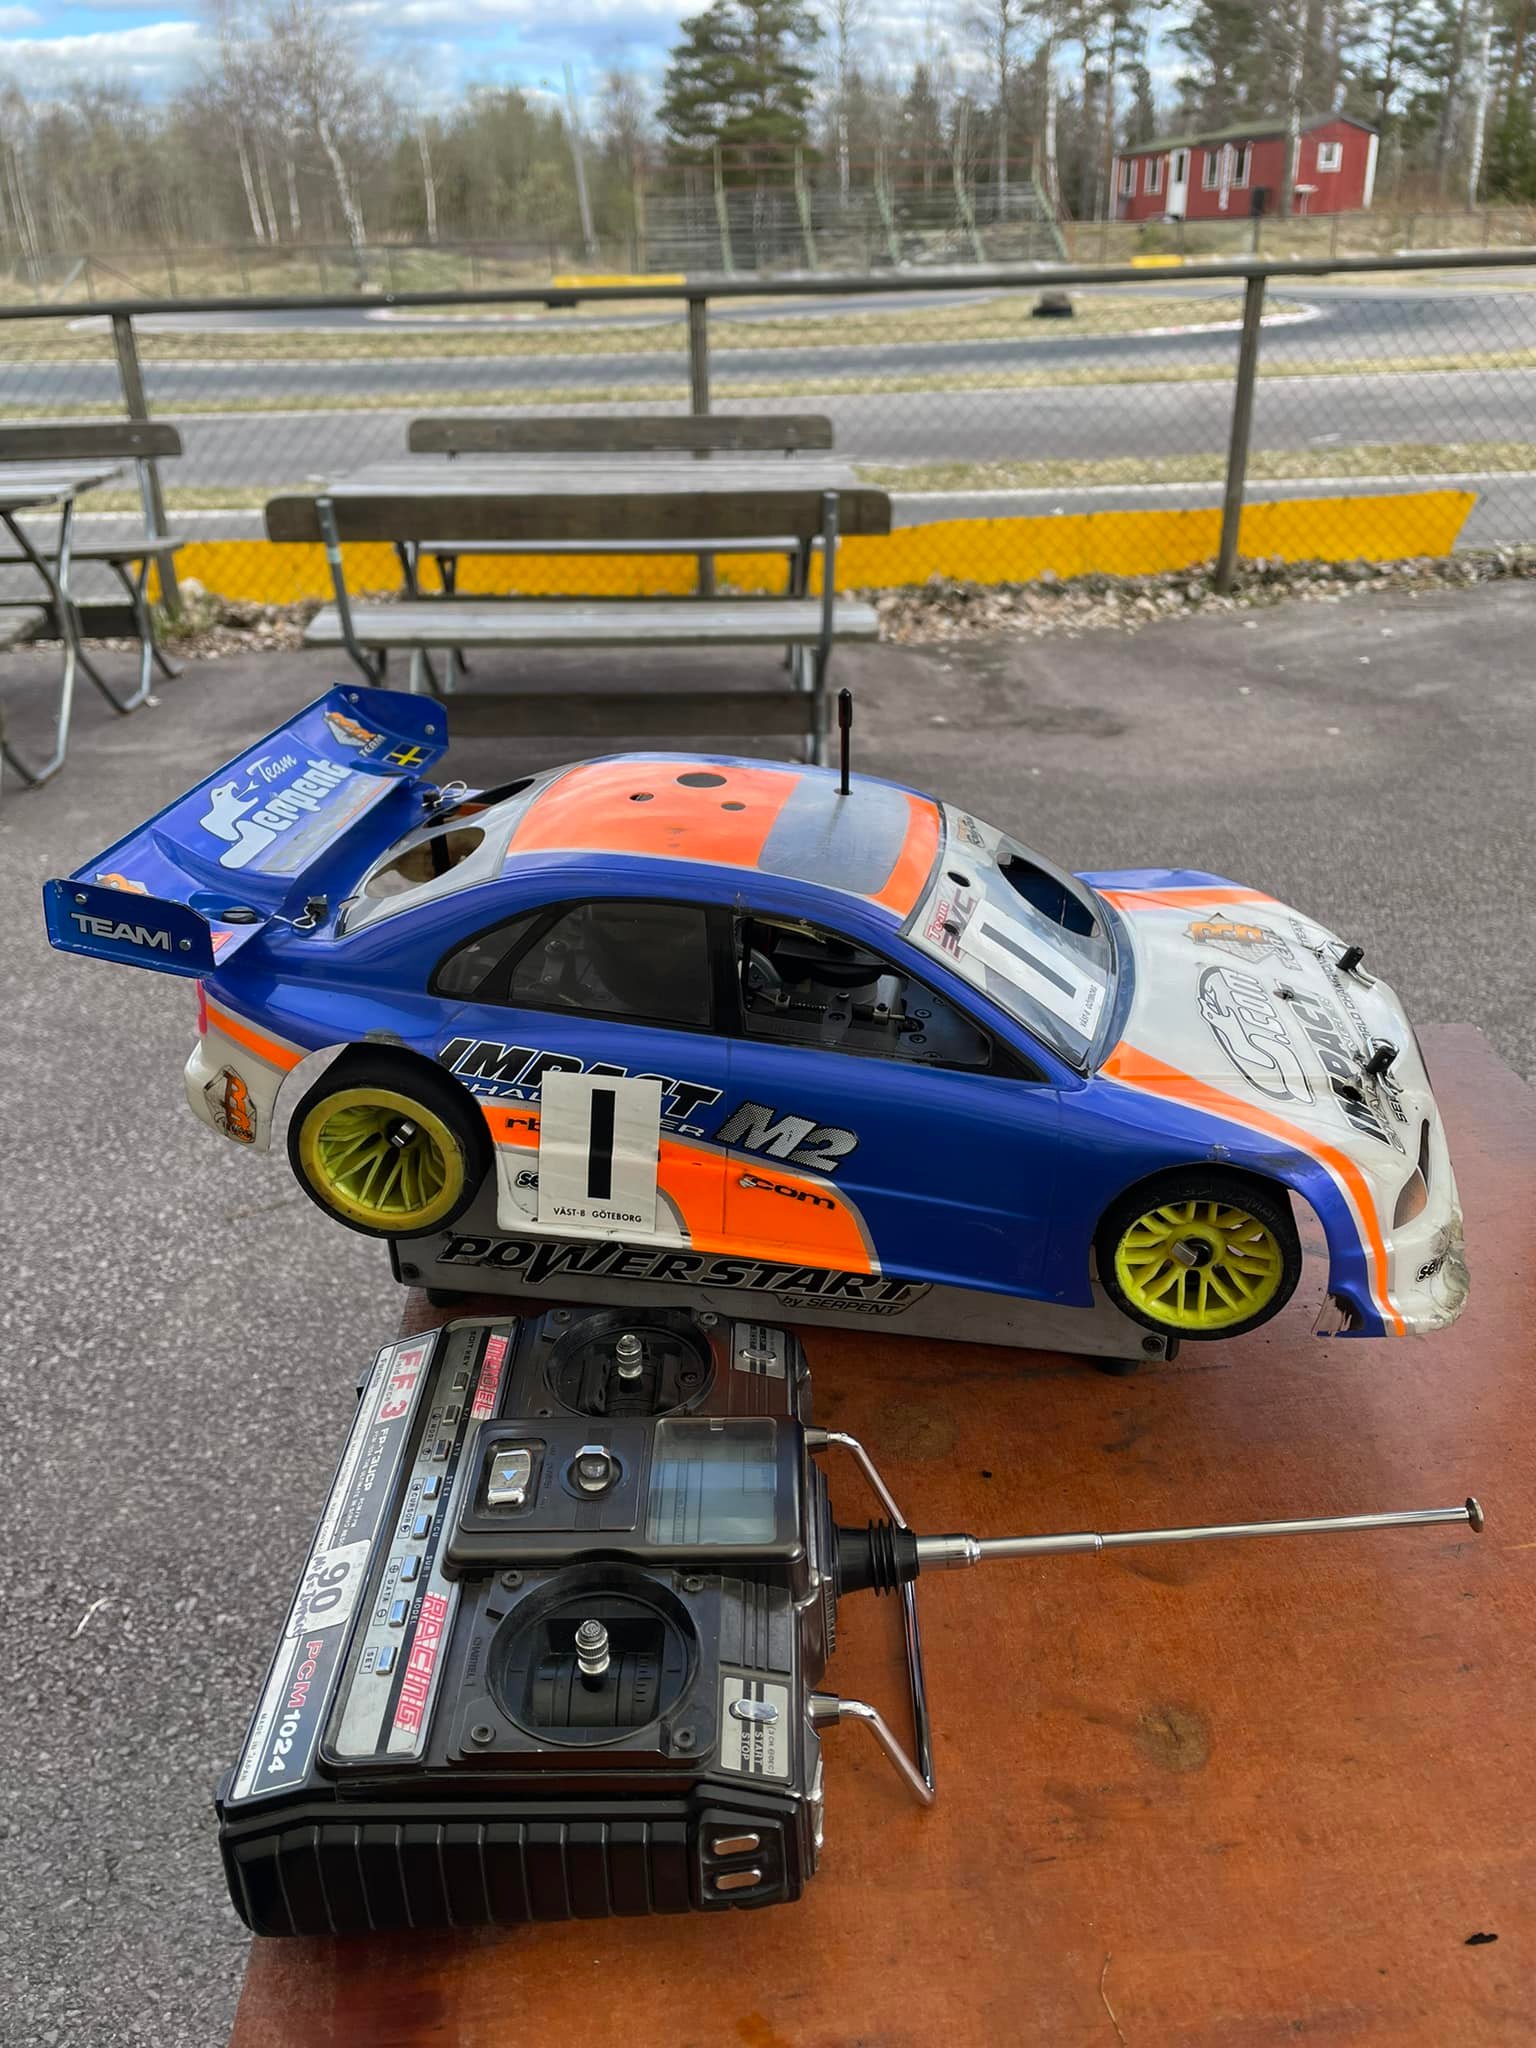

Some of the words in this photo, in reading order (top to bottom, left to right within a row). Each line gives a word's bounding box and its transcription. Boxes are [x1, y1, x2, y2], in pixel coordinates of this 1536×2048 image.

[246, 753, 298, 783] Team
[70, 912, 171, 951] TEAM
[926, 901, 950, 943] Team
[587, 1089, 616, 1200] 1
[714, 1101, 860, 1172] M2
[591, 1209, 643, 1223] GÖTEBORG
[437, 1233, 704, 1285] POWER
[700, 1257, 926, 1301] START
[783, 1295, 804, 1307] by
[807, 1298, 901, 1314] SERPENT
[404, 1492, 419, 1523] CURSOR
[309, 1562, 350, 1613] 90
[383, 1579, 394, 1602] DATA
[409, 1597, 423, 1625] MODEL
[365, 1652, 375, 1669] SET
[395, 1593, 448, 1733] RACING
[741, 1731, 750, 1760] STOP
[754, 1731, 764, 1766] START
